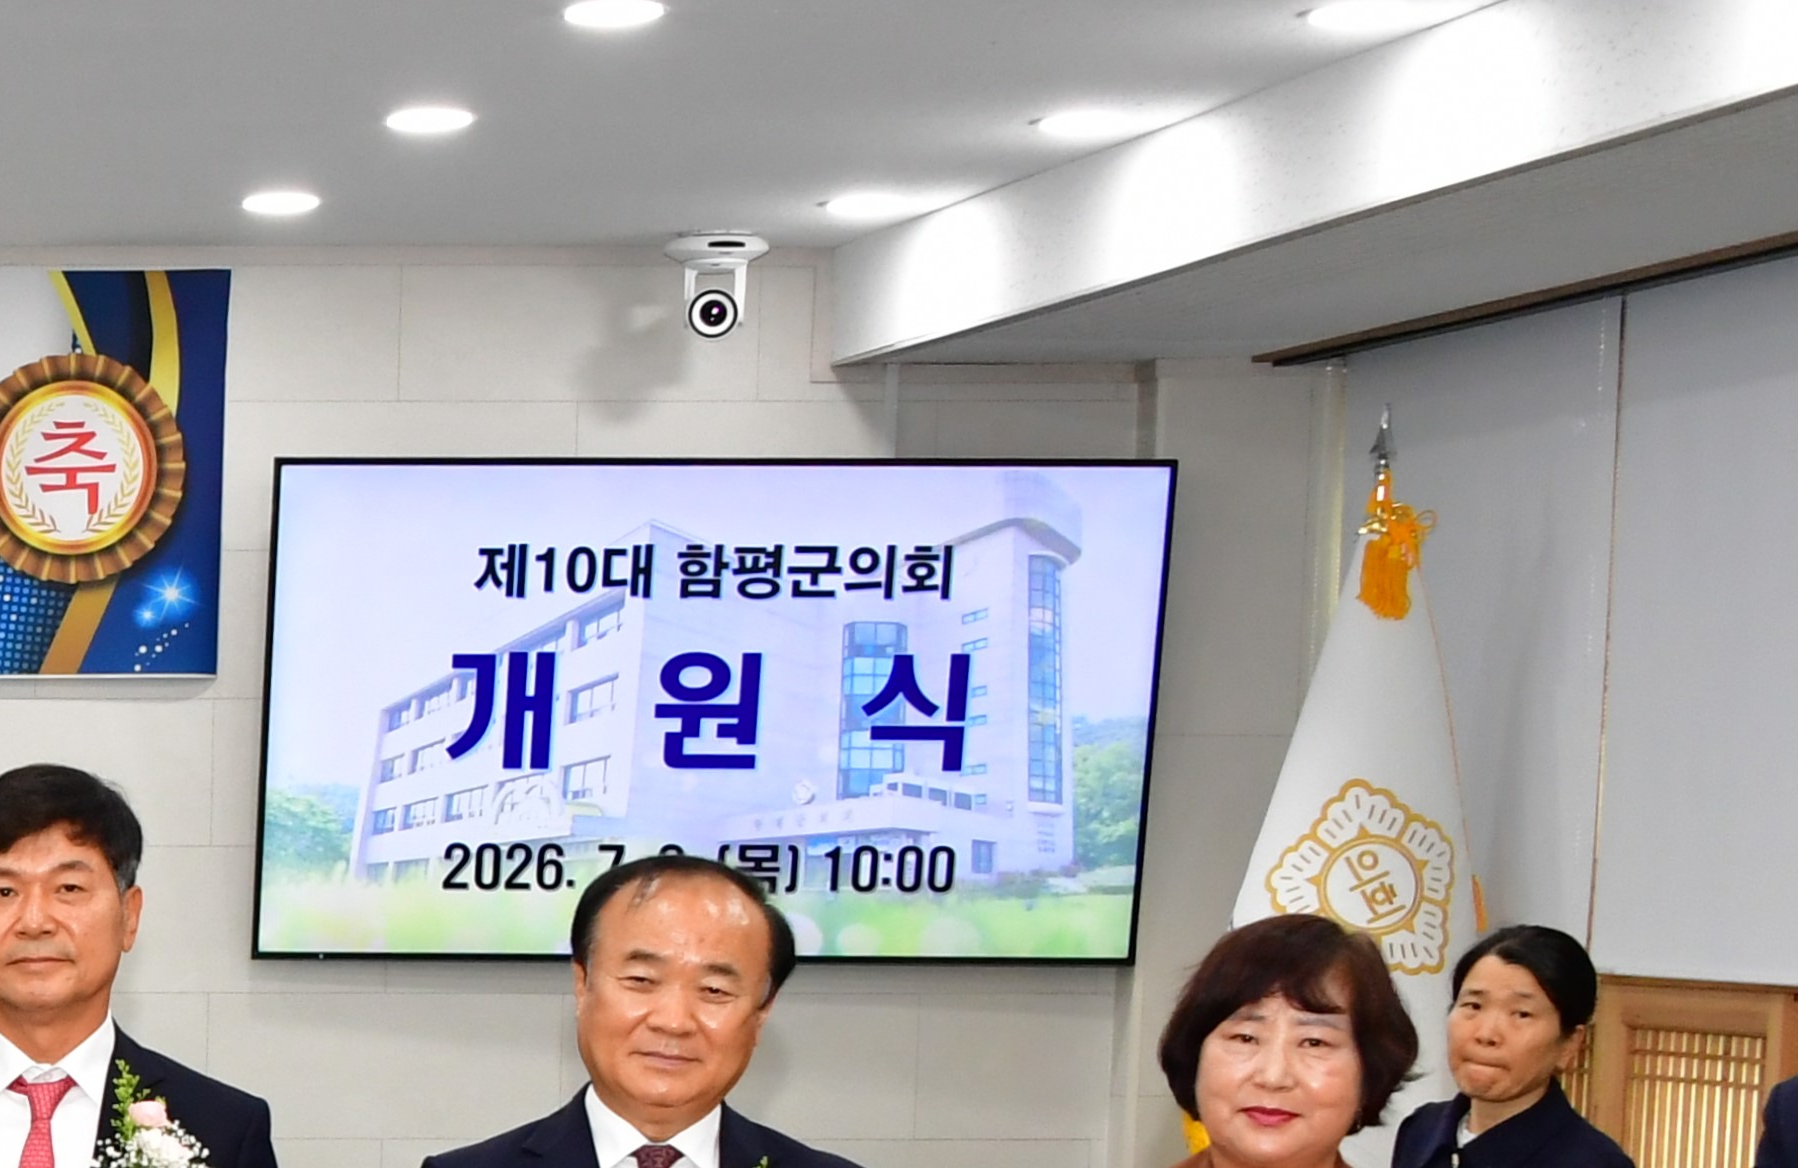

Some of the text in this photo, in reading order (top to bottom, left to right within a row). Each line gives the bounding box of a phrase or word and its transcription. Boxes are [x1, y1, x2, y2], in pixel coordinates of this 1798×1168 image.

[25, 421, 117, 515] 축
[476, 544, 954, 601] 제10대 함평군의회
[443, 843, 576, 891] 2026.
[826, 845, 956, 894] 10:00
